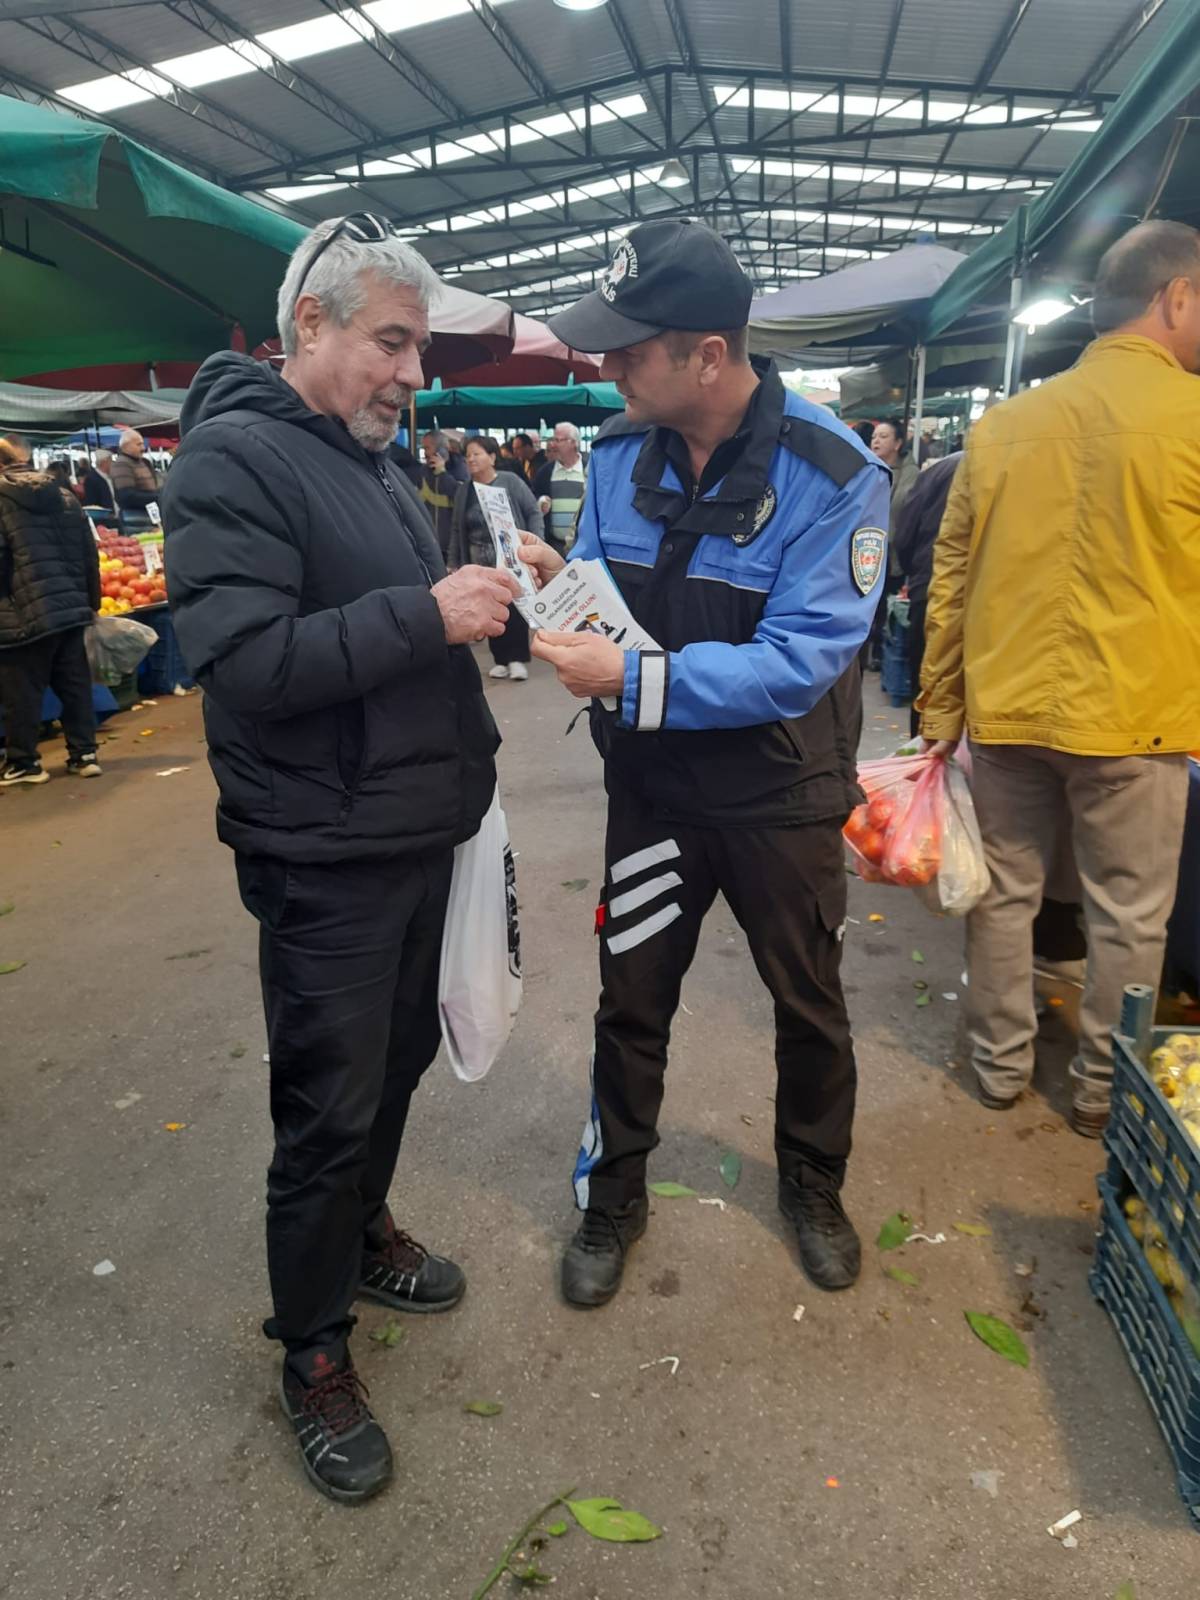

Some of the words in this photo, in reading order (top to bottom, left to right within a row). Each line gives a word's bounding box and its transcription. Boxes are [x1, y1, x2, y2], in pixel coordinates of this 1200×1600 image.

[552, 587, 571, 605] TELEFON
[559, 612, 579, 631] UYANIK
[579, 594, 597, 611] OLUN!
